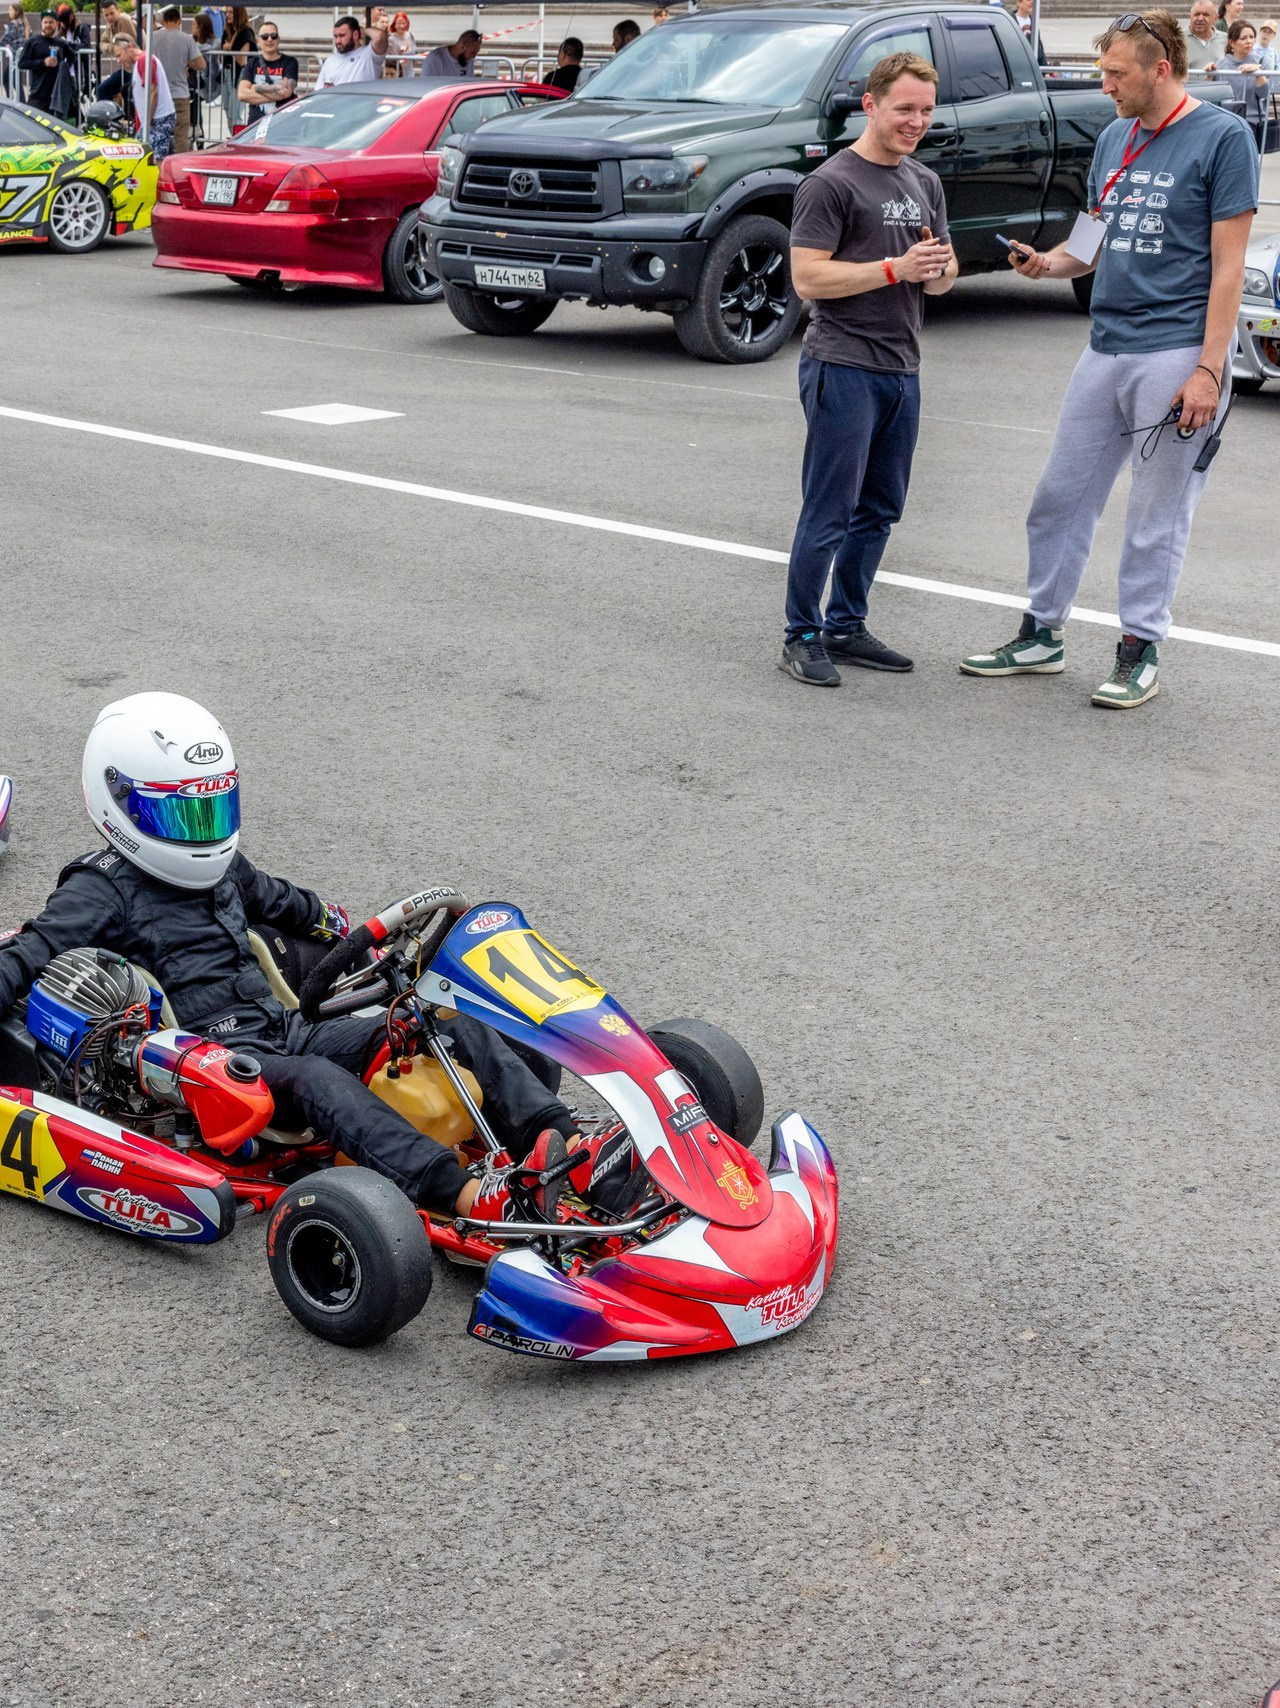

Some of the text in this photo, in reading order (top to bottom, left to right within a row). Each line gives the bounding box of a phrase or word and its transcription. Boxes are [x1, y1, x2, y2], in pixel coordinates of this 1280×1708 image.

[220, 177, 233, 189] 110
[223, 192, 233, 201] 190
[527, 270, 541, 284] 62
[188, 744, 220, 761] Arai
[194, 777, 231, 794] TULA
[474, 913, 504, 930] TULA
[485, 932, 600, 1006] 14
[672, 1105, 707, 1128] MIR
[90, 1159, 122, 1176] ПАНИН
[94, 1151, 125, 1169] Роман
[100, 1192, 172, 1229] TULA
[114, 1189, 160, 1214] Karting
[745, 1285, 793, 1311] Karting
[762, 1284, 806, 1325] TULA
[489, 1329, 574, 1357] PAROLIN
